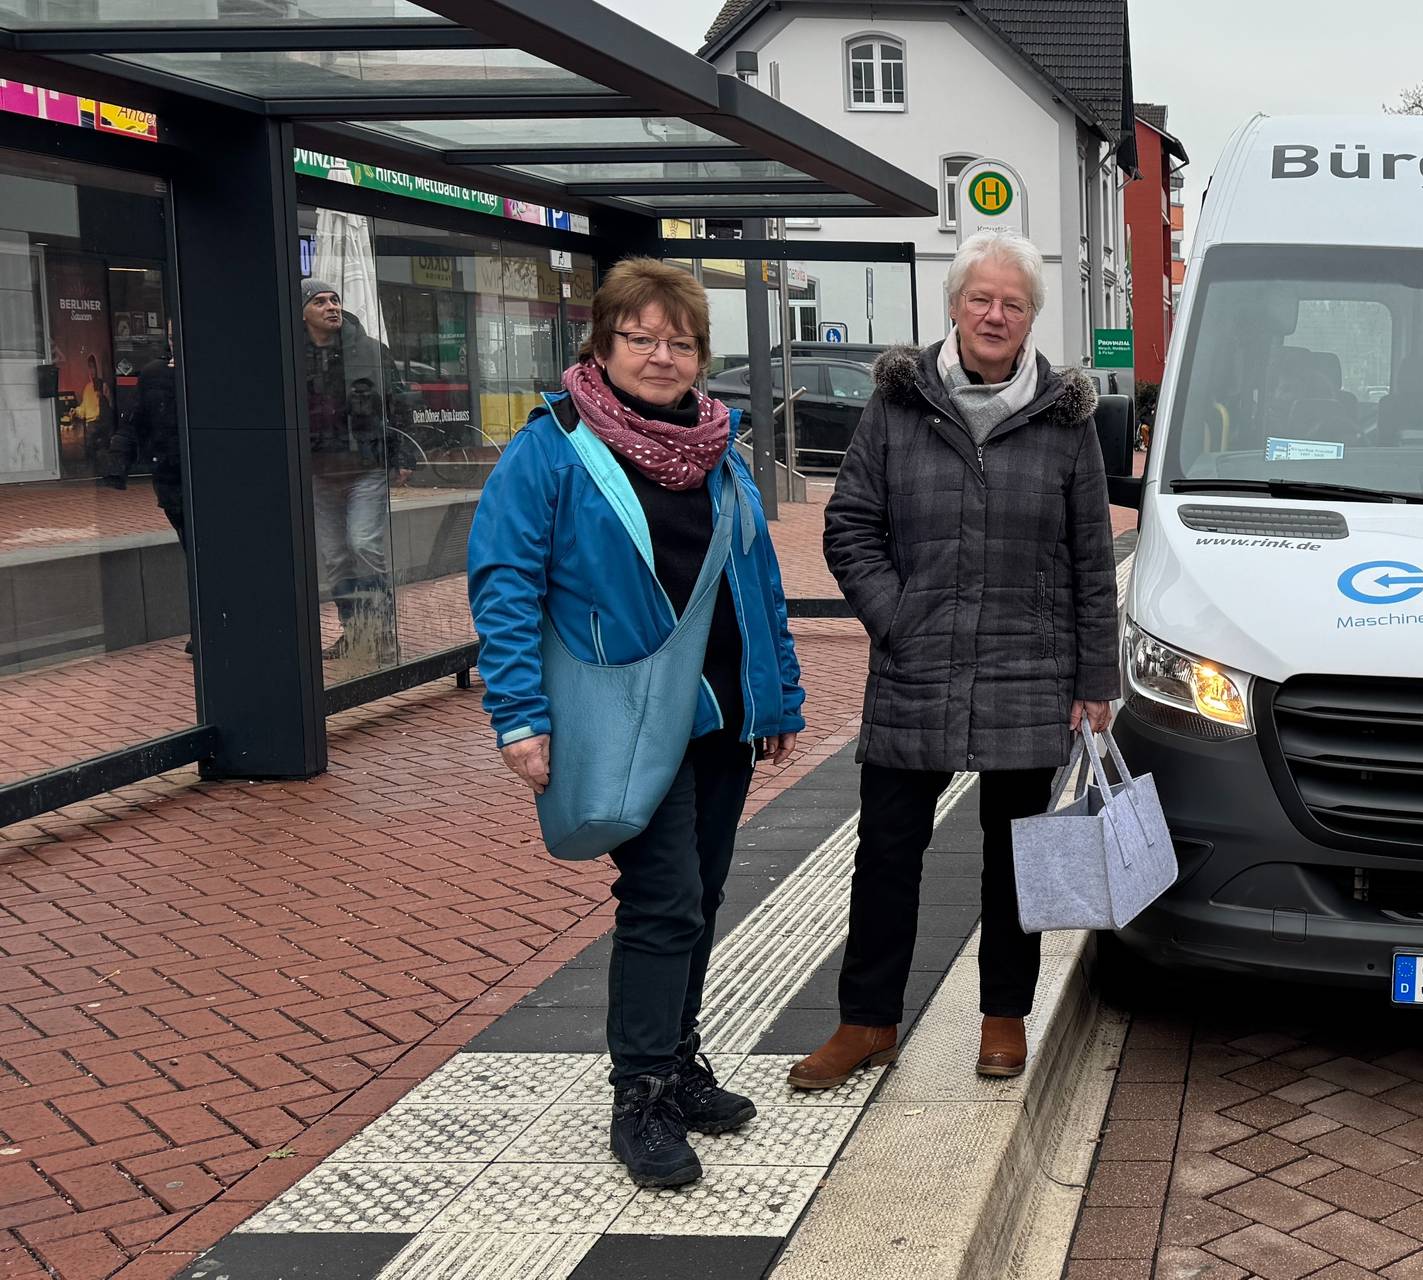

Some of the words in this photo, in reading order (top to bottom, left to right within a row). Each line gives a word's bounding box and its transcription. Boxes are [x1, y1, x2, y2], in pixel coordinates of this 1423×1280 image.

[981, 181, 1000, 206] H
[60, 299, 101, 311] BERLINER
[1196, 537, 1322, 552] www.rink.de
[1400, 983, 1410, 993] D
